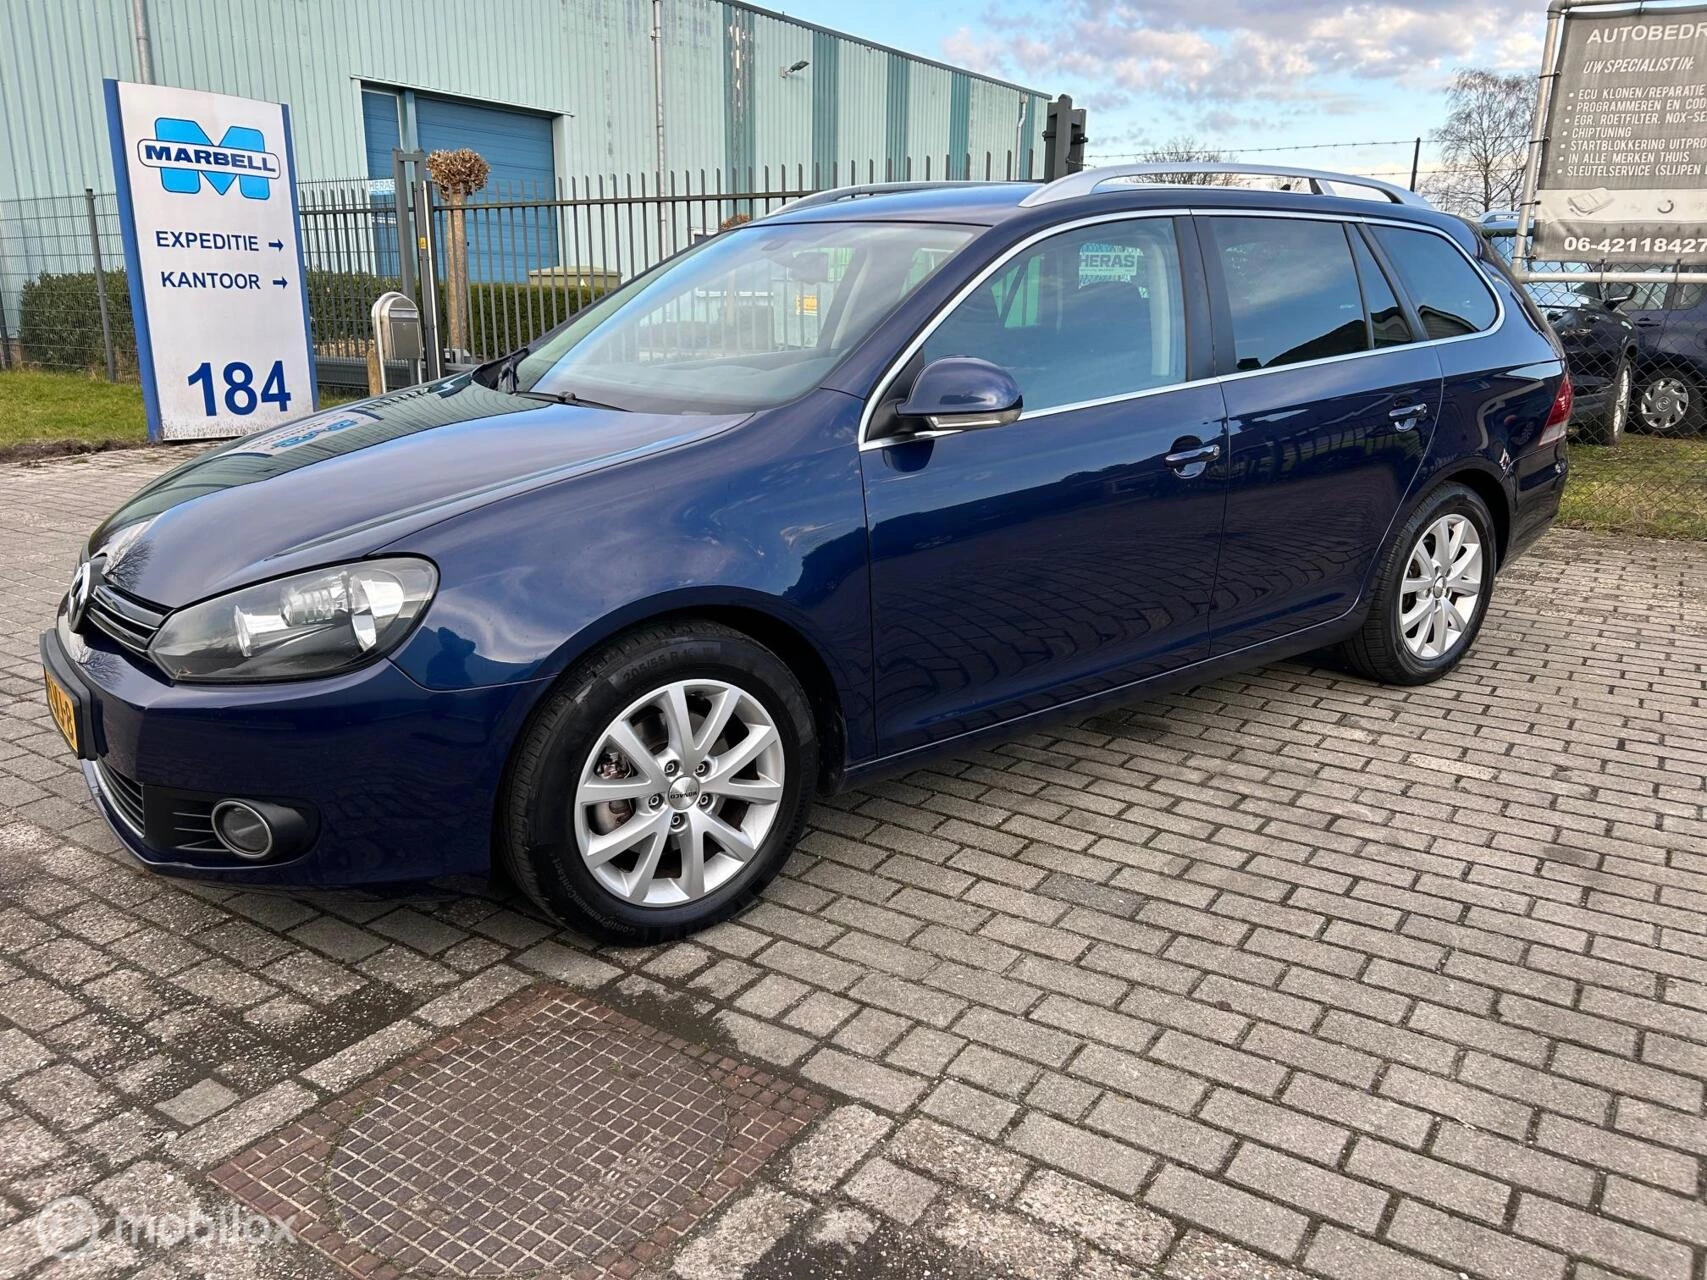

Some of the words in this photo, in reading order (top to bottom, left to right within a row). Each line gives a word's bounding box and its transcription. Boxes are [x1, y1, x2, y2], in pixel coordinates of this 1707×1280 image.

[1586, 23, 1707, 44] AUTOBEDR
[1583, 60, 1606, 74] UW
[1604, 57, 1680, 73] SPECIALIST
[1578, 89, 1598, 100] ECU
[1602, 84, 1706, 99] KLONEN/REPARATIE
[1576, 100, 1661, 112] PROGRAMMEREN
[1666, 99, 1681, 110] EN
[1665, 110, 1707, 124] NOX-SE
[1572, 127, 1632, 139] CHIPTUNING
[1570, 138, 1666, 151] STARTBLOKKERING
[1669, 137, 1707, 149] UITPRO
[145, 144, 277, 173] MARBELL
[1568, 153, 1579, 164] IN
[1582, 152, 1607, 164] ALLE
[1611, 152, 1655, 164] MERKEN
[1660, 151, 1690, 163] THUIS
[1567, 164, 1651, 177] SLEUTELSERVICE
[1655, 163, 1701, 176] (SLIJPEN
[156, 231, 260, 251] EXPEDITIE
[1563, 236, 1707, 254] 06-42118427
[160, 271, 262, 290] KANTOOR
[187, 359, 292, 417] 184
